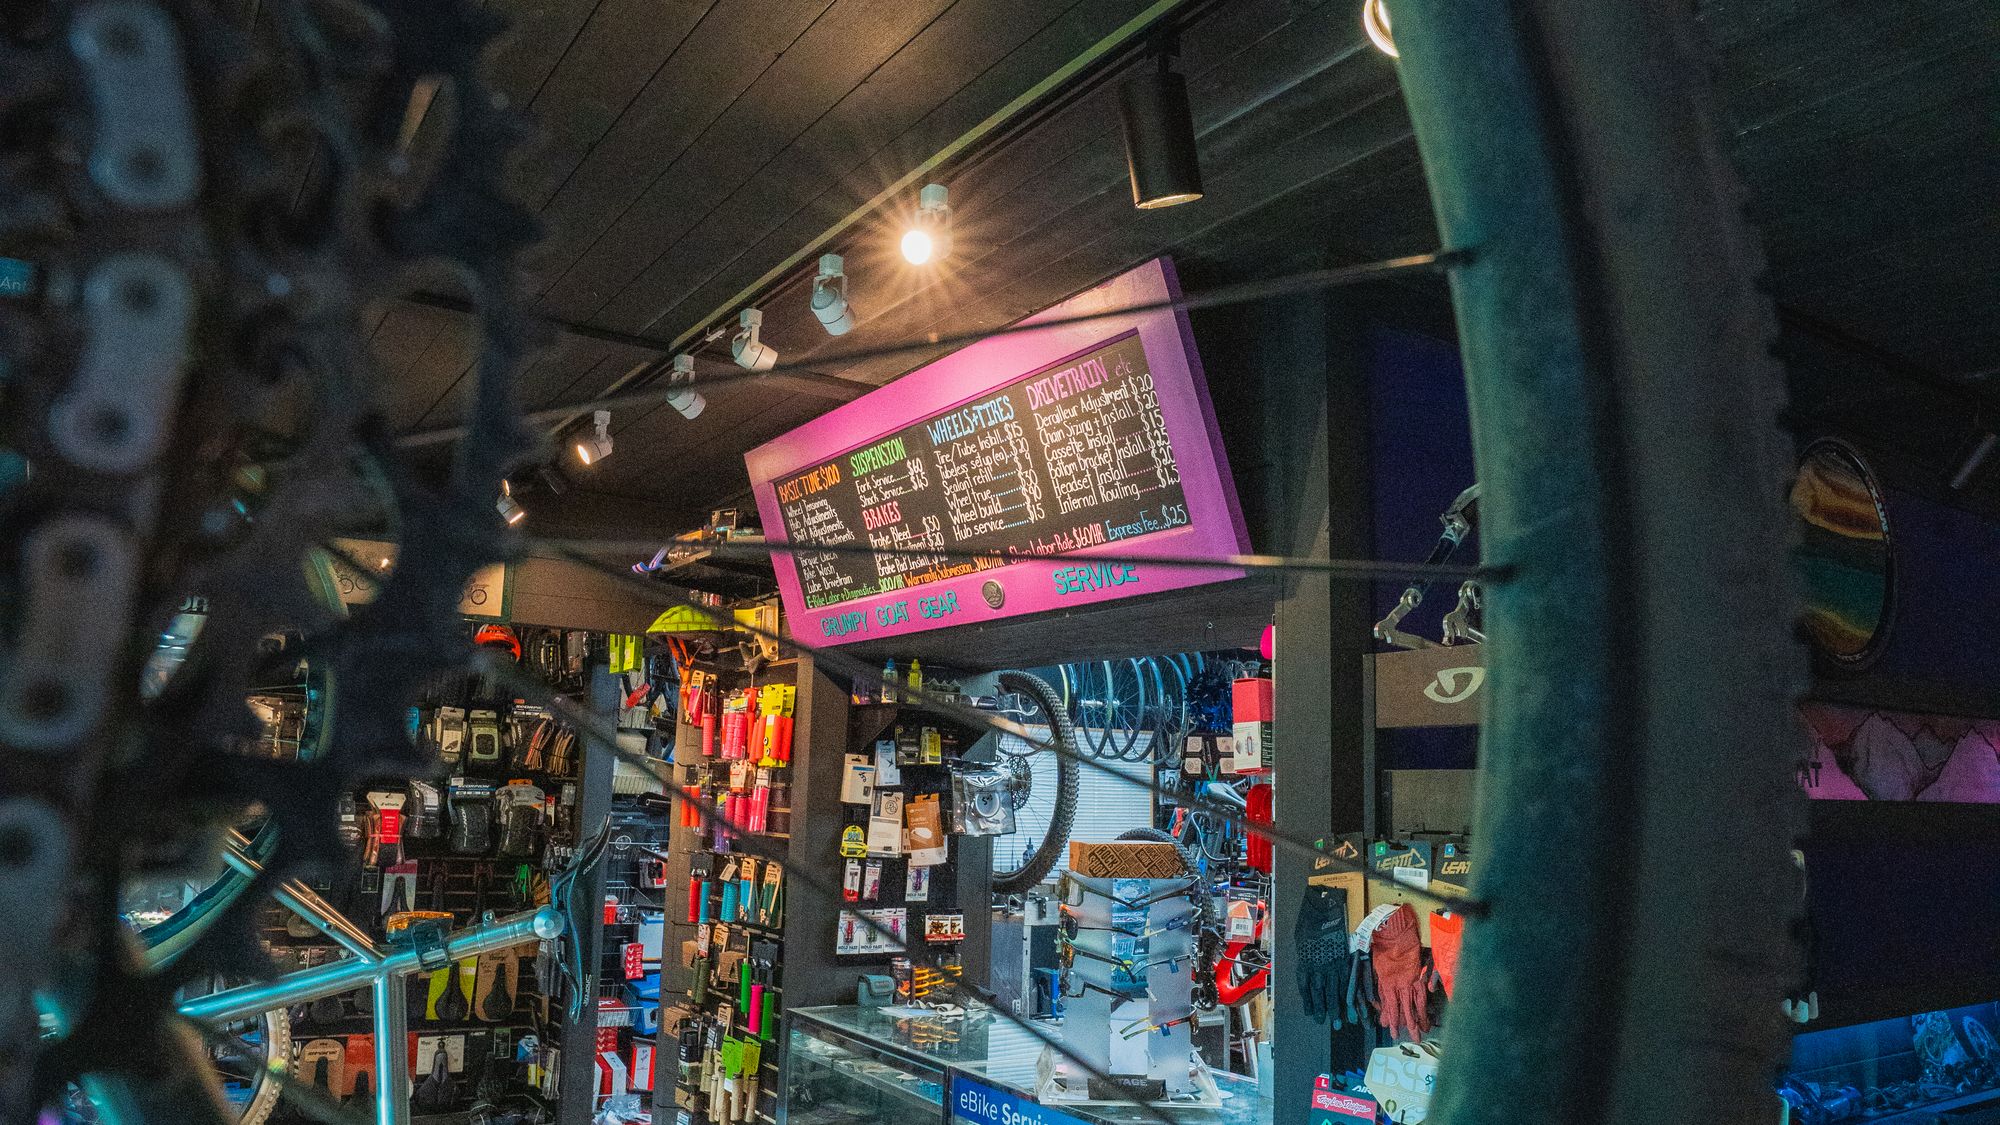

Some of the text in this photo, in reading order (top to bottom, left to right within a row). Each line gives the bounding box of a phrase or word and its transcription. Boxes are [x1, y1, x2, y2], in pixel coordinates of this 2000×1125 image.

[1026, 354, 1133, 410] DRIVETRAIN etc
[1034, 374, 1153, 430] Derailleur Adjustment $20
[1004, 421, 1023, 440] $15
[1039, 427, 1065, 446] Chain
[1063, 415, 1094, 437] Sizing
[1098, 400, 1134, 426] Install
[1135, 390, 1159, 413] $20
[1044, 409, 1165, 461] Cassette Install $15
[850, 437, 907, 477] SUSPENSION
[936, 461, 968, 480] Tubeless
[1010, 437, 1029, 457] $20
[1047, 428, 1170, 480] Bottom Bracket Install $25
[778, 479, 802, 504] BASIC
[855, 478, 872, 495] Fork
[906, 457, 923, 476] $60
[942, 473, 973, 496] Sealant
[1052, 469, 1093, 497] Headset
[1094, 459, 1128, 486] Install
[786, 502, 803, 518] Wheel
[859, 491, 879, 508] Shock
[945, 488, 972, 510] Wheel
[971, 488, 992, 503] true
[948, 503, 978, 525] Wheel
[977, 496, 1002, 519] build
[1056, 487, 1098, 515] Internal
[1098, 481, 1140, 503] Routing
[788, 507, 838, 531] Hub Adjustments
[862, 500, 902, 531] BRAKES
[953, 503, 1045, 541] Hub service $15
[1055, 533, 1075, 551] Rate
[1105, 520, 1143, 542] Express
[1140, 510, 1160, 533] Fee
[1162, 504, 1187, 528] $25
[868, 515, 940, 549] Brake Bleed $30
[927, 532, 944, 548] $20
[816, 563, 835, 577] Wash
[876, 560, 896, 577] Brake
[895, 555, 908, 573] Pad
[806, 572, 853, 594] Lube Drivetrain
[820, 557, 1140, 637] GRUMPY GOAT GEAR SERVICE
[1096, 845, 1120, 867] ROCK
[1440, 860, 1473, 875] LEAT
[1321, 1079, 1328, 1087] L
[961, 1090, 1049, 1125] eBike Servi
